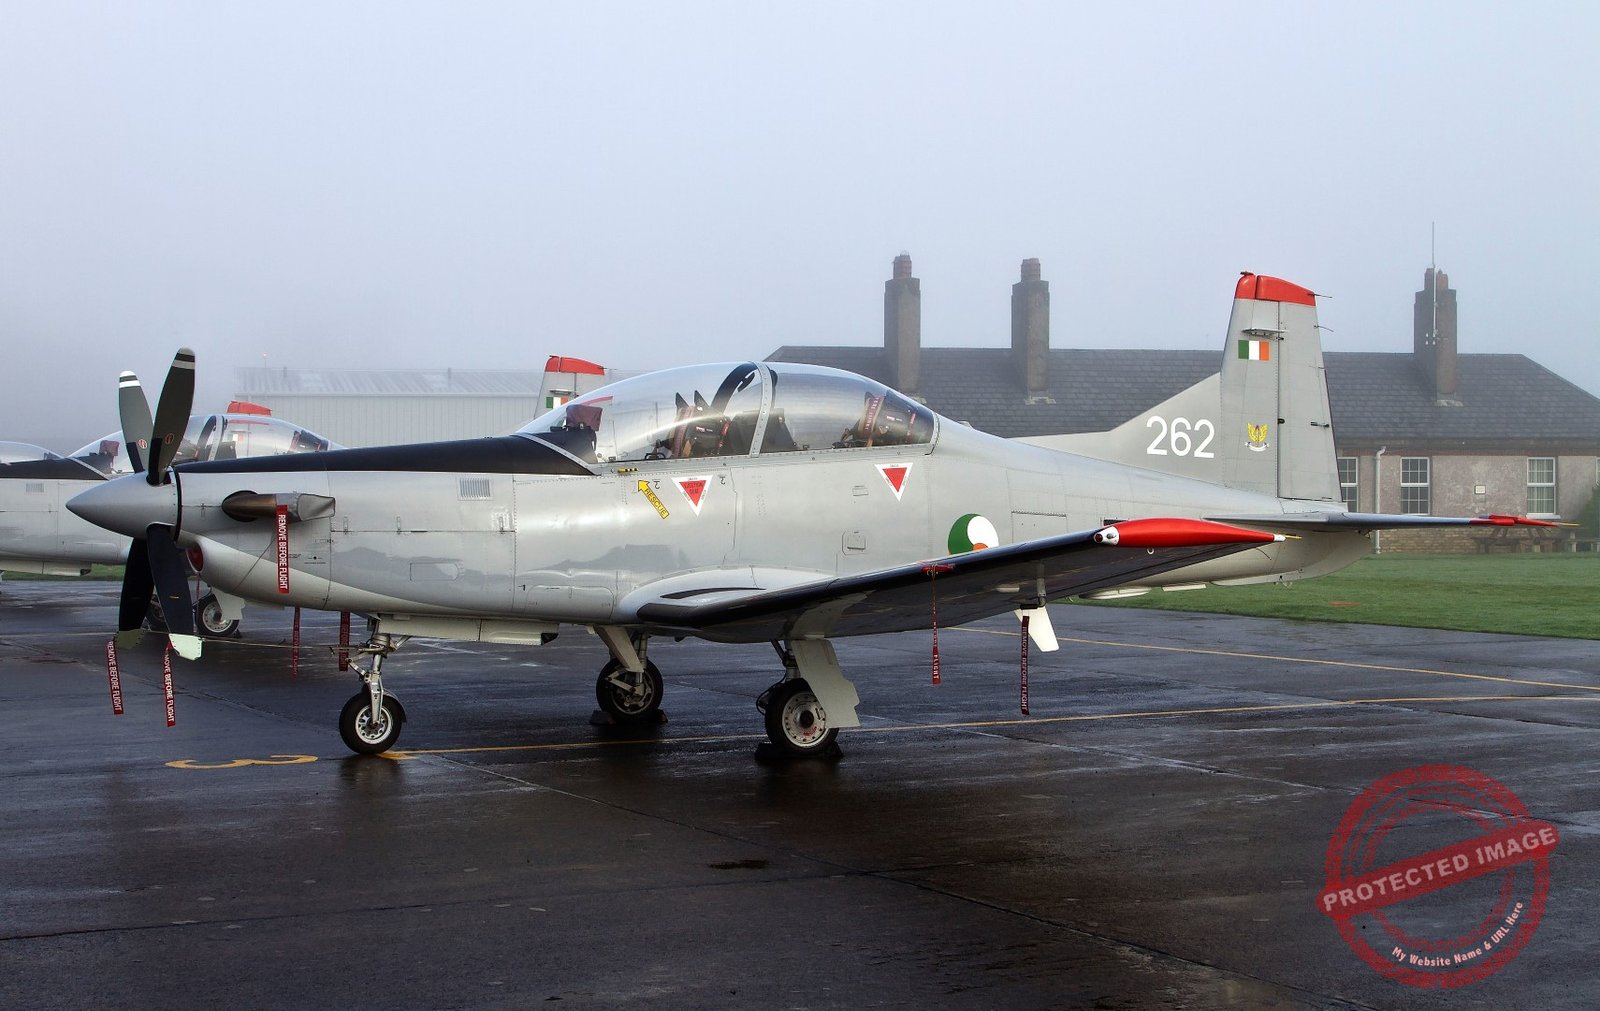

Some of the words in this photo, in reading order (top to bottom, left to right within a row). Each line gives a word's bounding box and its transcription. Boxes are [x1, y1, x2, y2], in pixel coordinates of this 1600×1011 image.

[1146, 415, 1215, 459] 262
[644, 488, 667, 517] RESCUE
[278, 514, 286, 541] REMOVE
[279, 541, 287, 567] BEFORE
[279, 567, 288, 590] FLIGHT
[106, 640, 116, 666] REMOVE
[109, 665, 119, 690] BEFORE
[165, 673, 174, 699] BEFORE
[112, 690, 122, 711] FLIGHT
[166, 699, 175, 722] FLIGHT
